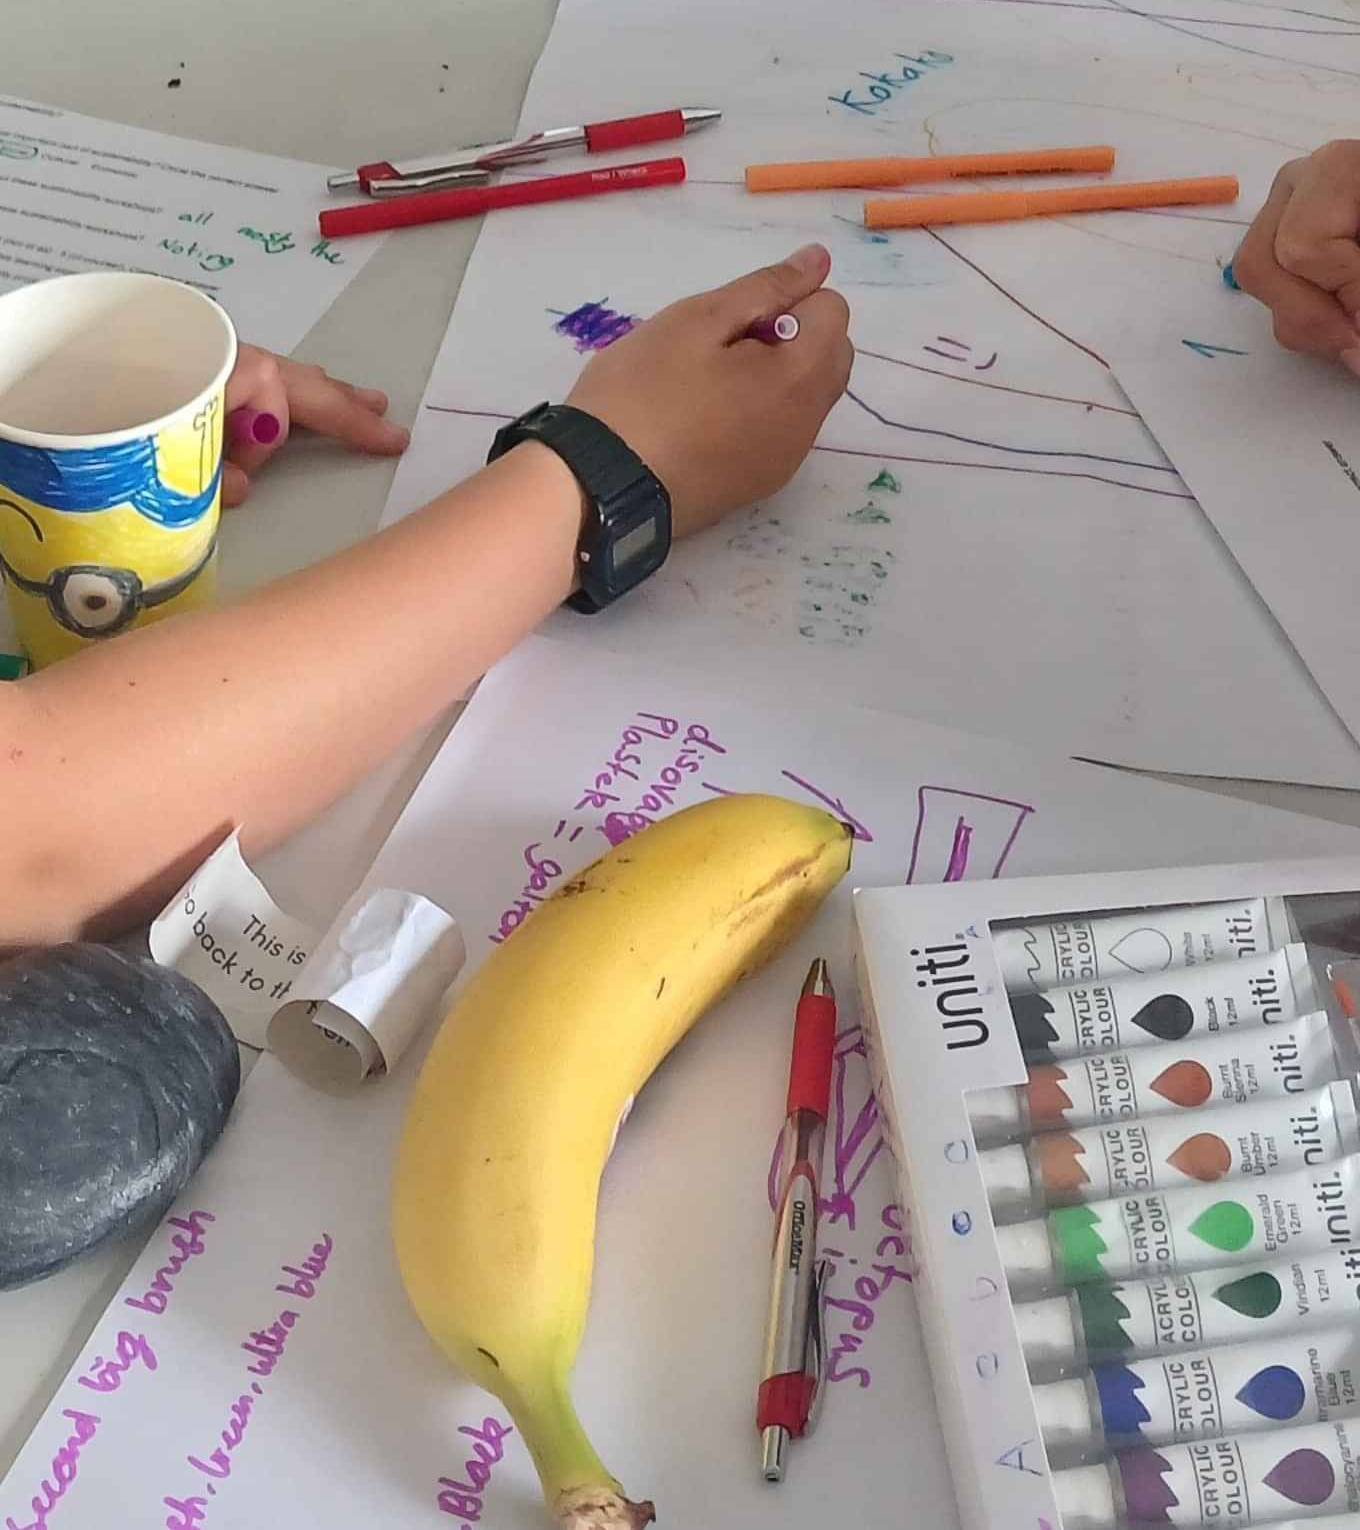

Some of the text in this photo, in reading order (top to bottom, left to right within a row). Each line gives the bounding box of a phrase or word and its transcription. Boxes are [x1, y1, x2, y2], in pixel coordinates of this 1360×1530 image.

[193, 911, 238, 975] back
[240, 968, 265, 991] to
[242, 914, 306, 965] This is
[1054, 922, 1075, 980] CRYLIC
[1072, 918, 1093, 977] OLOUR
[1228, 910, 1256, 958] niti.
[911, 932, 989, 1050] uniti.
[1074, 990, 1096, 1046] CRYLIC
[1093, 988, 1114, 1045] OLOUR
[1249, 970, 1282, 1025] niti.
[1090, 1059, 1114, 1114] CRYLIC
[1110, 1056, 1132, 1112] OLOUR
[1270, 1034, 1294, 1093] niti.
[1106, 1130, 1132, 1189] RYLIC
[1127, 1128, 1149, 1186] OLOUR
[1293, 1107, 1322, 1166] niti.
[1126, 1200, 1149, 1263] CRYLIC
[1256, 1194, 1278, 1252] Emerald
[1274, 1200, 1288, 1244] Green
[1288, 1204, 1302, 1235] 12ml
[276, 1233, 333, 1299] blue
[1291, 1263, 1309, 1316] Viridian
[1314, 1270, 1330, 1302] 12ml
[1150, 1278, 1175, 1342] ACRYL
[1170, 1363, 1194, 1432] CRYLIC
[1190, 1360, 1216, 1428] OLOUR
[1327, 1374, 1340, 1406] Blue
[1340, 1370, 1356, 1404] 12ml
[1194, 1446, 1220, 1518] CRYLIC
[1216, 1442, 1242, 1515] OLOUR
